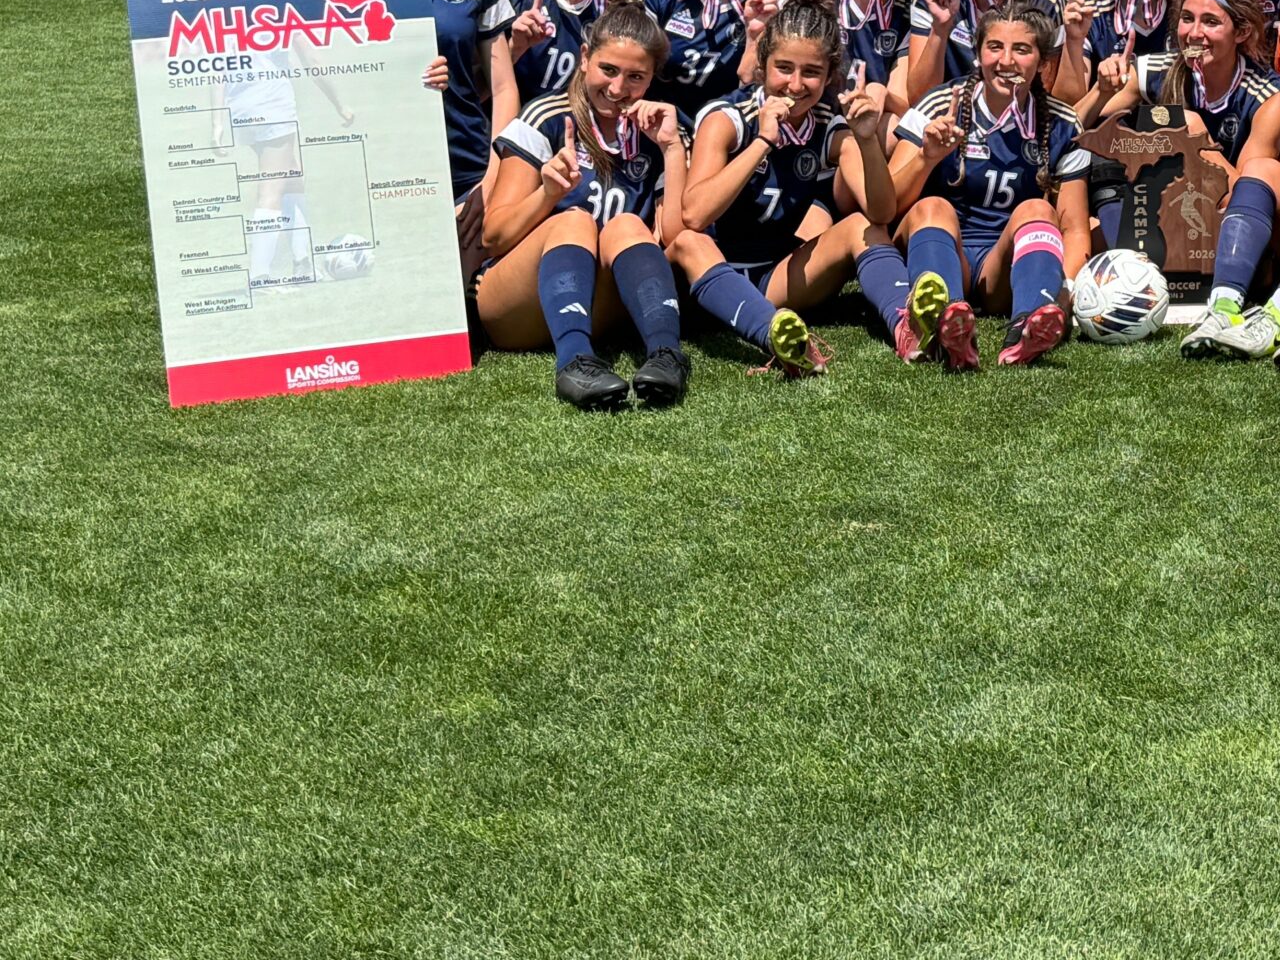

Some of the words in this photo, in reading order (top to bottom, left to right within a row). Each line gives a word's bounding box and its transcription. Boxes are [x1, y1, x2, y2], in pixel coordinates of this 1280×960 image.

[168, 1, 364, 58] MHSAA
[167, 55, 253, 76] SOCCER
[540, 47, 576, 90] 19
[676, 48, 722, 88] 37
[168, 73, 244, 89] SEMIFINALS
[246, 72, 255, 82] &
[258, 68, 302, 81] FINALS
[304, 61, 386, 78] TOURNAMENT
[233, 116, 266, 125] Goodrich
[305, 136, 326, 144] Detroit
[327, 134, 350, 142] Country
[351, 133, 363, 141] Day
[168, 143, 194, 151] Almont
[168, 160, 189, 168] Eaton
[191, 157, 216, 167] Rapids
[238, 173, 261, 181] Detroit
[261, 170, 288, 179] Country
[289, 169, 302, 177] Day
[370, 181, 391, 189] Detroit
[392, 179, 414, 188] Country
[415, 177, 427, 185] Day
[983, 169, 1019, 209] 15
[372, 186, 437, 201] CHAMPIONS
[172, 199, 196, 207] Detroit
[198, 196, 225, 205] Country
[226, 194, 240, 203] Day
[587, 180, 626, 227] 30
[758, 187, 783, 224] 7
[206, 205, 221, 213] City
[277, 215, 291, 224] City
[1028, 232, 1061, 248] CAPTAIN
[1188, 249, 1216, 260] 2026
[194, 267, 212, 275] West
[213, 263, 242, 273] Catholic
[263, 278, 281, 286] West
[282, 275, 311, 284] Catholic
[1168, 281, 1202, 290] occer
[185, 300, 203, 309] West
[204, 297, 236, 307] Michigan
[216, 303, 248, 313] Academy
